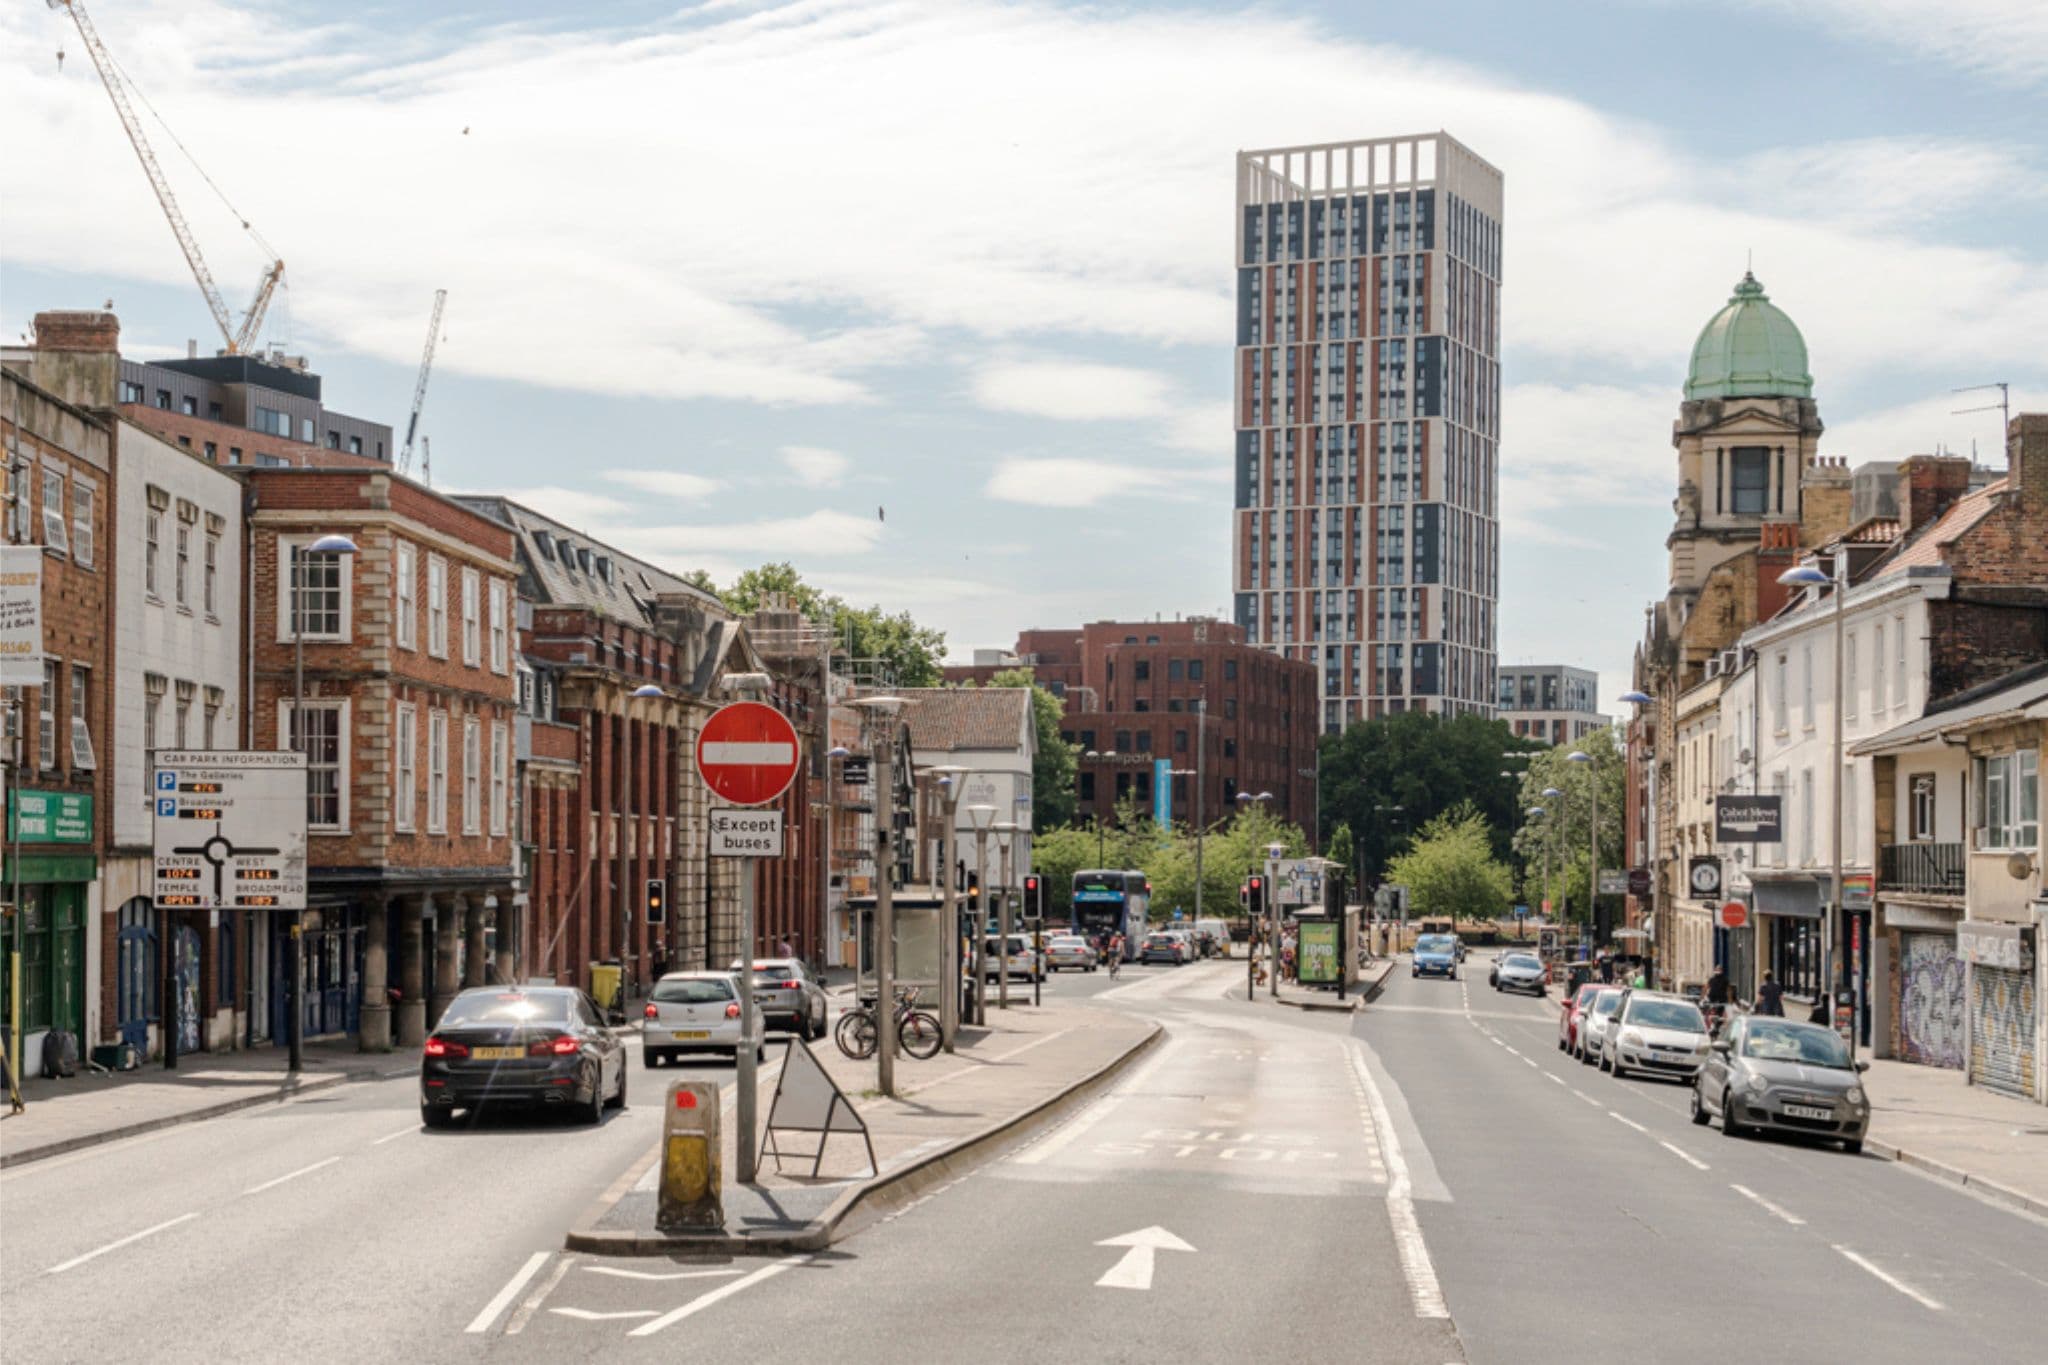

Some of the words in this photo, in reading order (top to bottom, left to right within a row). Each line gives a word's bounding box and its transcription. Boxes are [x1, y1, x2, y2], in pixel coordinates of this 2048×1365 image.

[164, 755, 186, 763] CAR
[190, 755, 218, 763] PARK
[222, 755, 298, 764] INFORMATION
[181, 771, 197, 779] The
[200, 771, 243, 780] Galleries
[180, 798, 234, 806] Broadmead
[718, 816, 776, 832] Except
[724, 835, 771, 849] buses
[158, 857, 199, 866] CENTRE
[236, 858, 264, 866] WEST
[165, 869, 194, 879] 1074
[158, 883, 199, 892] TEMPLE
[236, 884, 303, 893] BROADMEAD
[164, 895, 194, 905] OPEN
[1092, 1142, 1339, 1162] STOP
